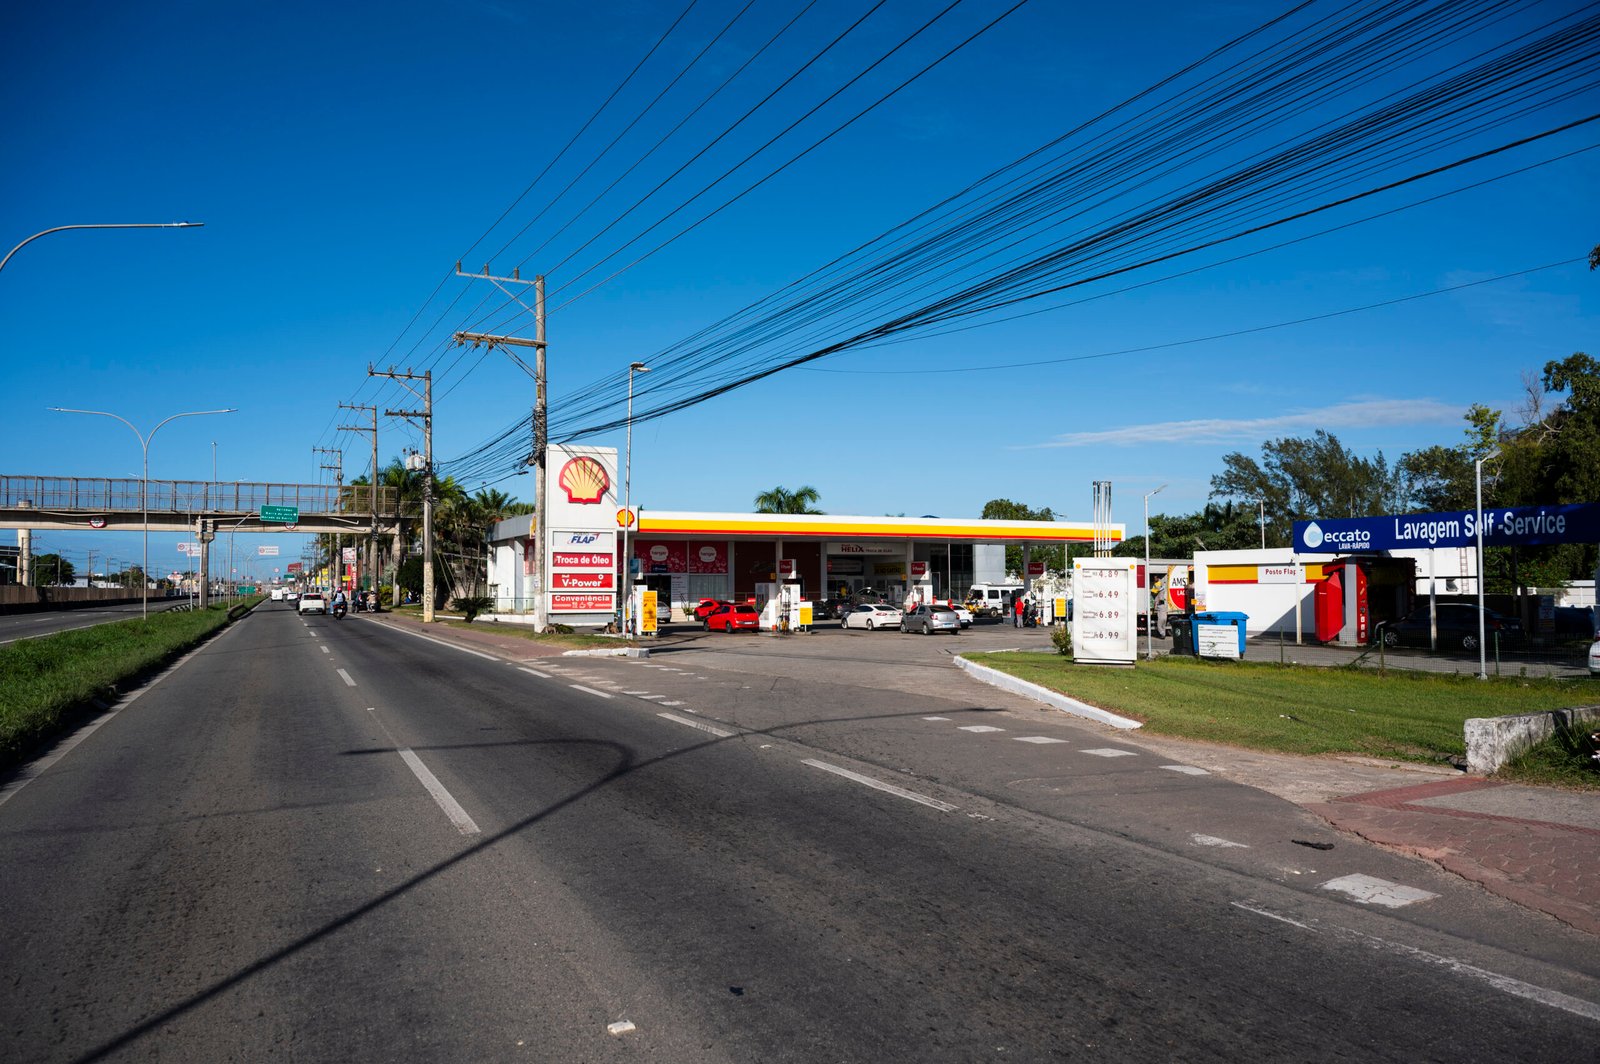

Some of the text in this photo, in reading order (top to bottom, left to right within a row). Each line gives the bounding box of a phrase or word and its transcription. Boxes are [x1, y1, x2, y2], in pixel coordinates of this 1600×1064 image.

[1394, 518, 1459, 544] Lavagem
[571, 536, 595, 544] FLAP
[556, 554, 609, 564] Troca de Óleo
